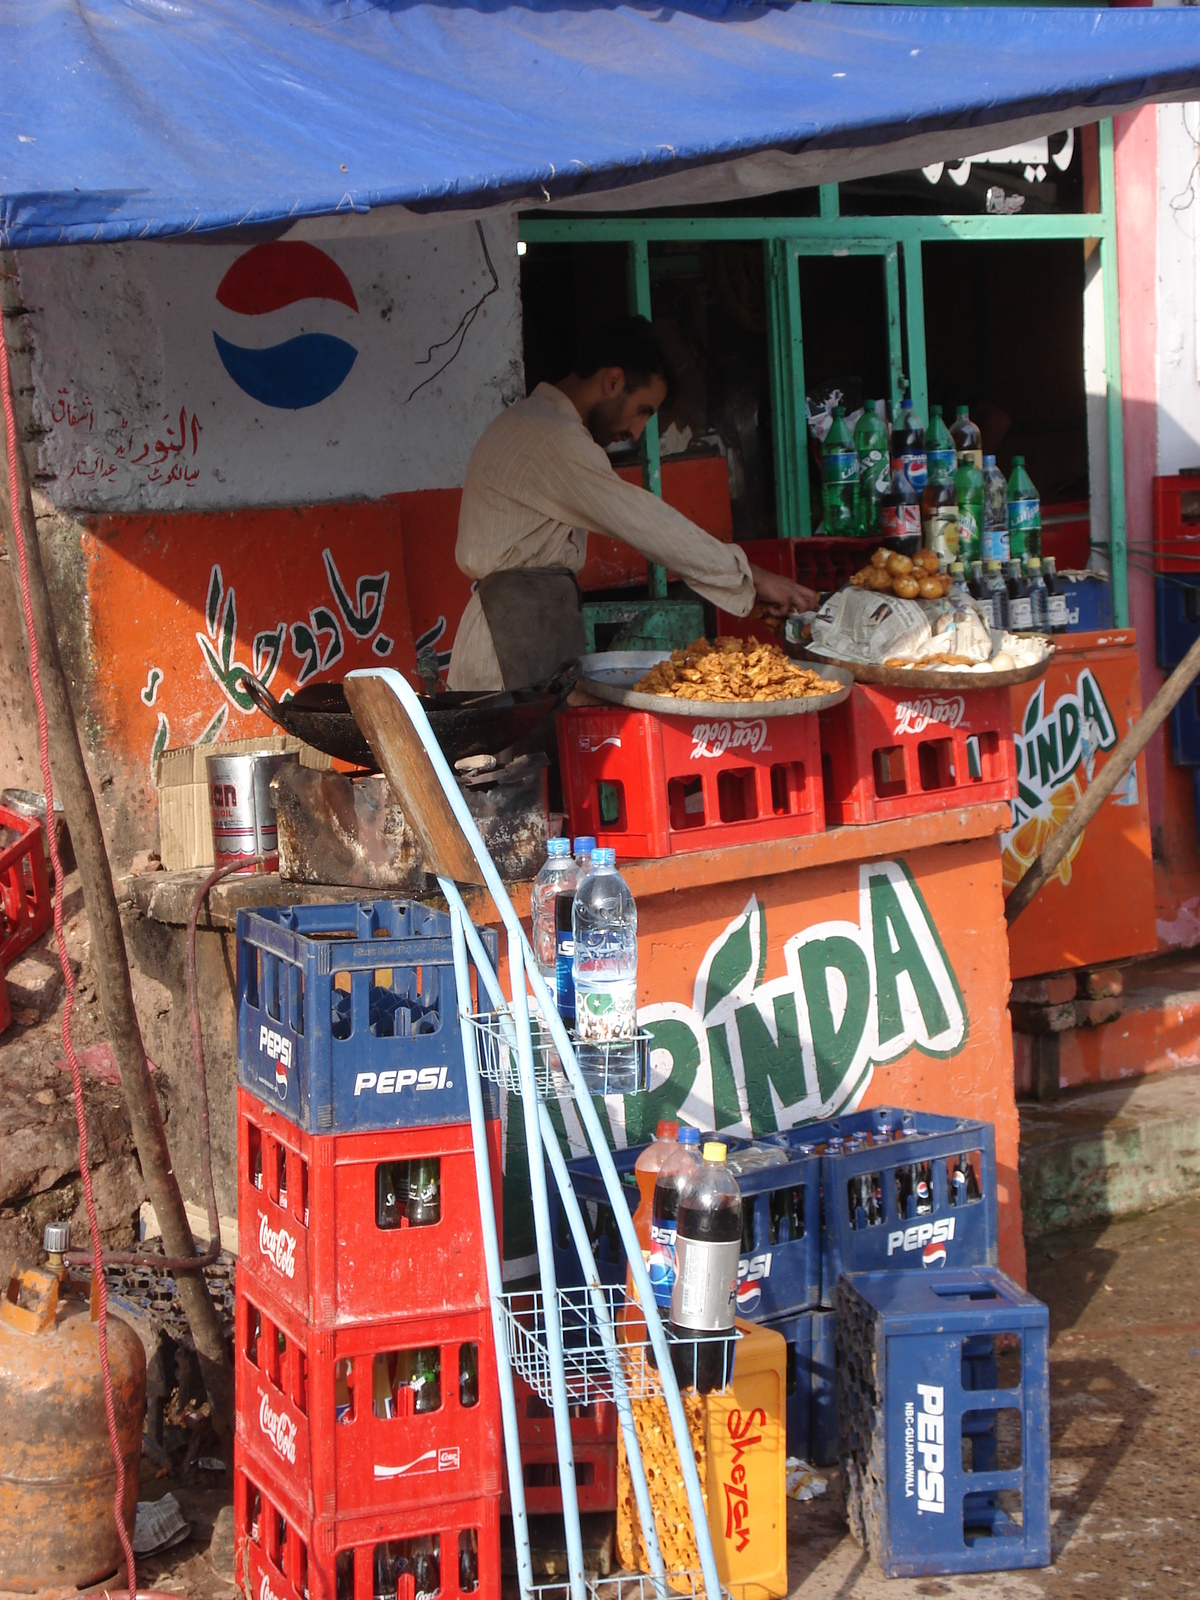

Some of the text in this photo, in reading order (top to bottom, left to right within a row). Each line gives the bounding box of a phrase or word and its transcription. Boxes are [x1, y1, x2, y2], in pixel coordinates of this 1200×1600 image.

[259, 1024, 292, 1069] PEPSI
[353, 1066, 448, 1096] PEPSI
[259, 1214, 297, 1279] Coca-Cola
[887, 1217, 956, 1257] PEPSI
[259, 1393, 297, 1465] Coca-Cola
[904, 1401, 915, 1498] NBC-GUJRANWALA
[916, 1383, 945, 1514] PEPSI
